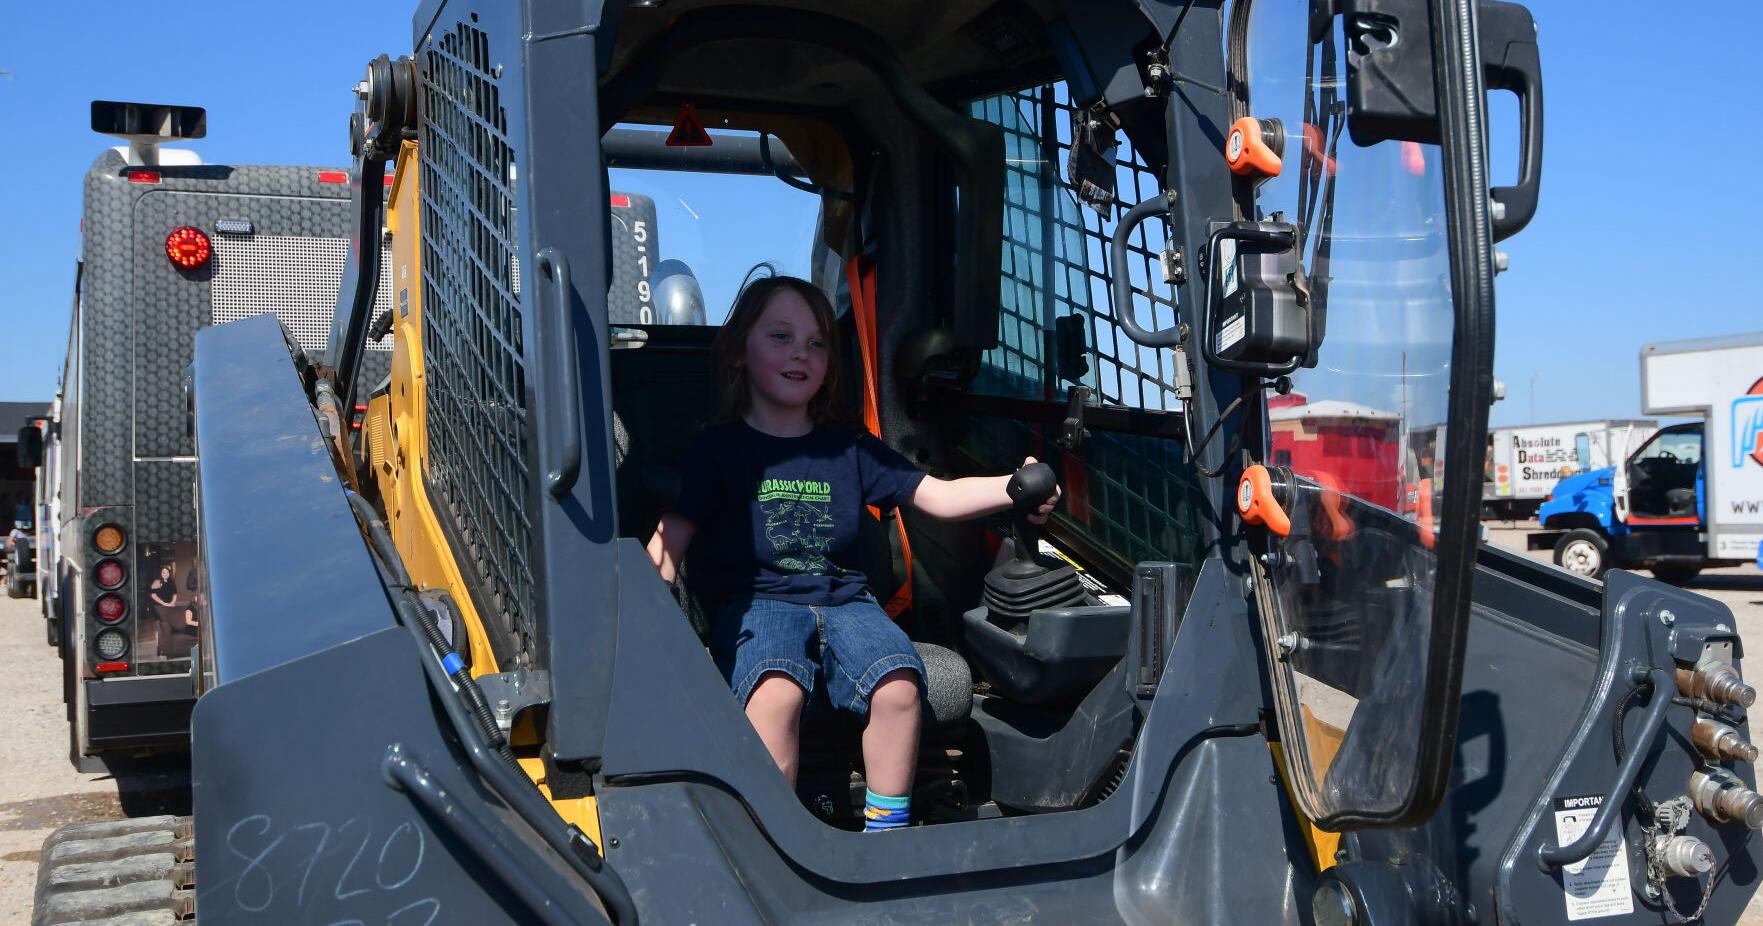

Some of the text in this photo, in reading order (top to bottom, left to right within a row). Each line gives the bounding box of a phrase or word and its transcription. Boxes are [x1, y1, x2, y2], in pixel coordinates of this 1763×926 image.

[1513, 435, 1561, 449] Absolute
[1518, 450, 1545, 464] Data
[796, 480, 831, 494] WORLD
[1731, 501, 1763, 514] WW
[1564, 795, 1604, 808] IMPORTAN
[227, 814, 425, 912] 8720
